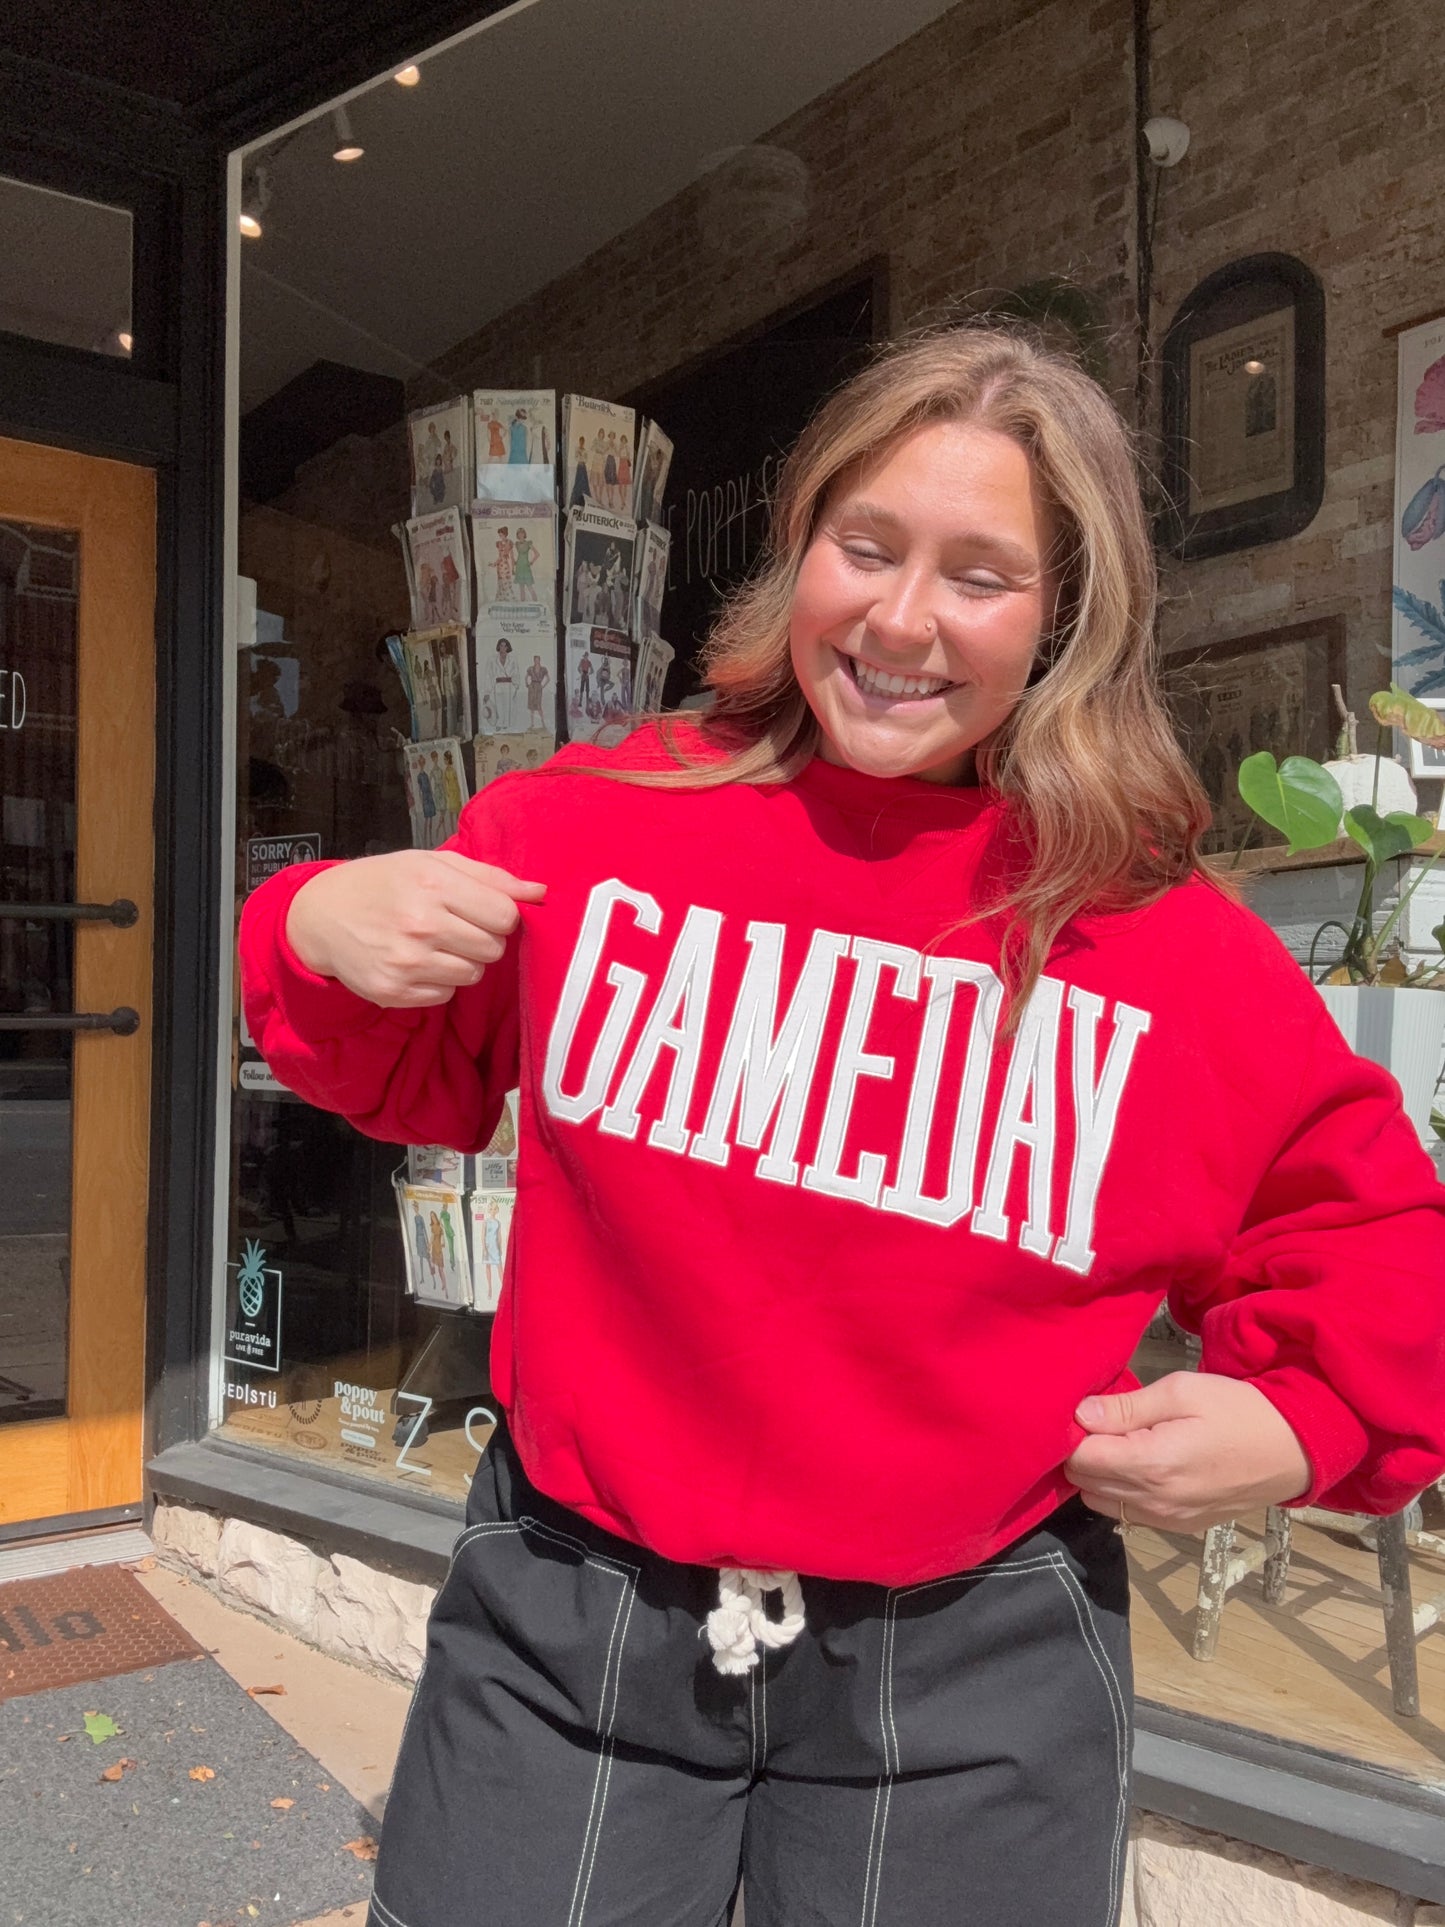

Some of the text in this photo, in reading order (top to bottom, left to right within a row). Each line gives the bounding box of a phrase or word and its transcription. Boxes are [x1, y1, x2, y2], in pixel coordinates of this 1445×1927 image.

[491, 505, 536, 517] Simplicity
[687, 473, 749, 583] POPPY
[251, 842, 293, 860] SORRY
[251, 863, 262, 873] NO
[243, 1069, 265, 1080] Follow
[542, 878, 1152, 1275] GAMEDAY
[229, 1330, 272, 1347] puravida
[334, 1381, 378, 1407] poppy
